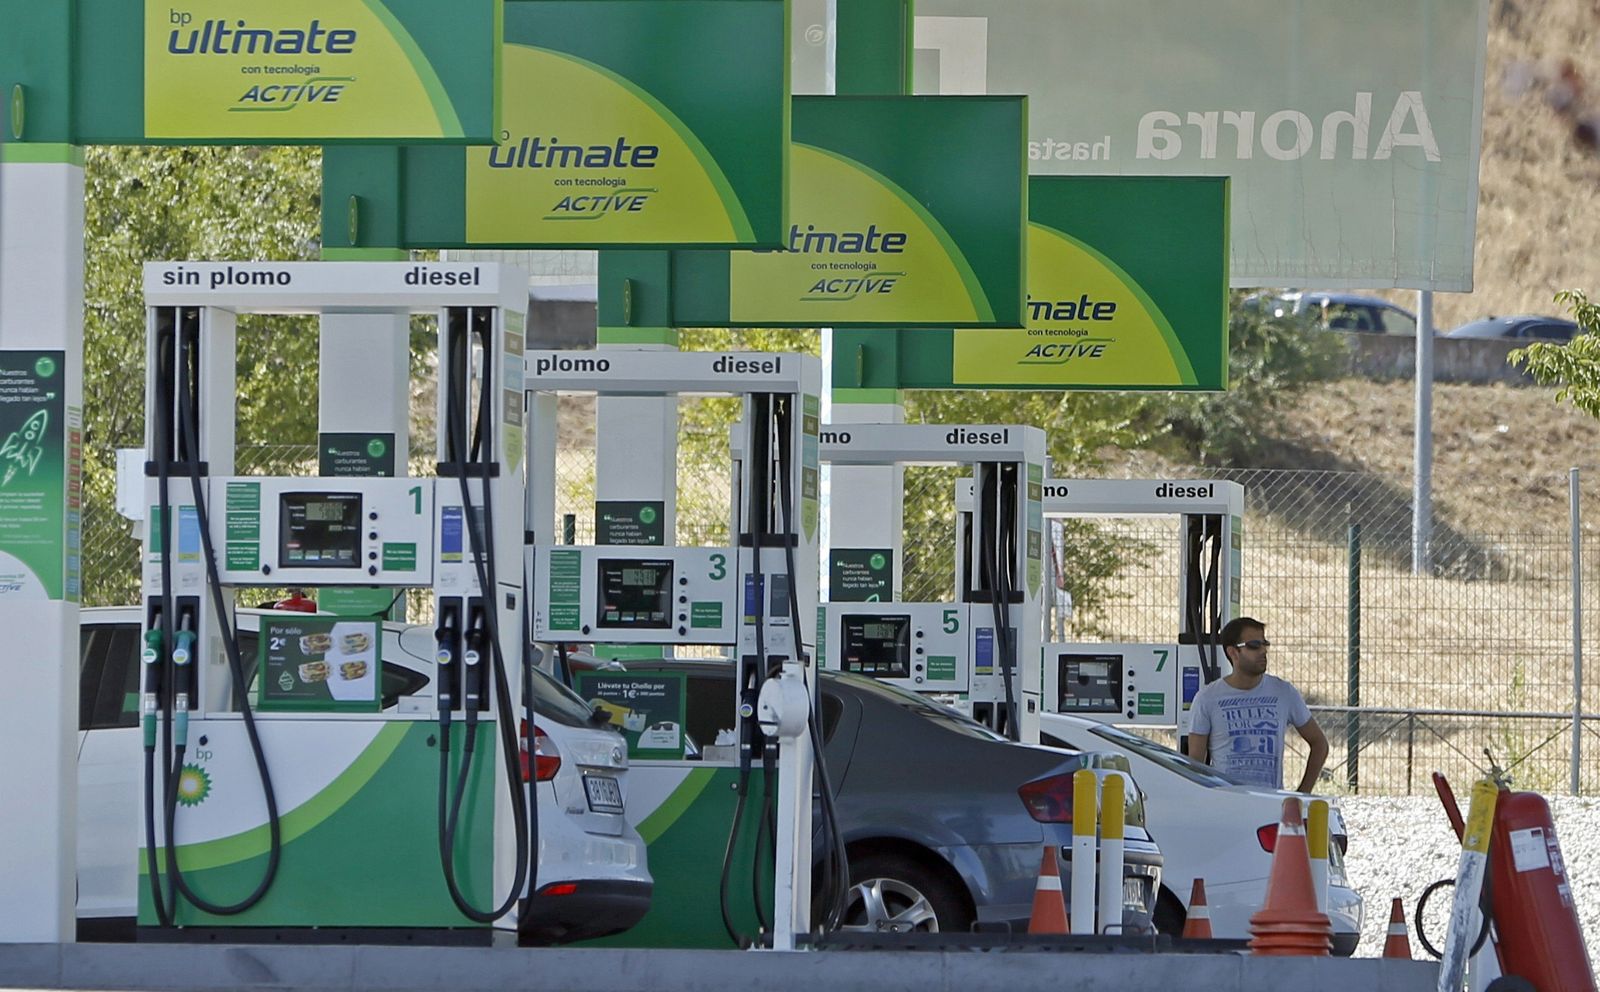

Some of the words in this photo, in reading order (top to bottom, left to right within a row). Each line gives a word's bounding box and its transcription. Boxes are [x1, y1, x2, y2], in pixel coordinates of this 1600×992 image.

[169, 9, 192, 26] bp
[169, 20, 357, 54] ultimate
[241, 66, 261, 74] con
[239, 85, 344, 102] ACTIVE
[488, 136, 659, 168] ultimate
[554, 178, 572, 186] con
[552, 195, 648, 212] ACTIVE
[752, 225, 907, 253] timate
[811, 262, 828, 270] con
[163, 266, 199, 286] sin
[210, 266, 291, 290] plomo
[404, 265, 479, 286] diesel
[808, 279, 896, 293] ACTIVE
[1025, 344, 1106, 358] ACTIVE
[536, 354, 610, 374] plomo
[713, 356, 781, 374] diesel
[946, 429, 1009, 445] diesel
[1155, 484, 1214, 498] diesel
[409, 486, 422, 515] 1
[708, 554, 726, 580] 3
[943, 610, 959, 634] 5
[270, 627, 283, 635] Por
[1153, 650, 1168, 672] 7
[196, 747, 213, 763] bp
